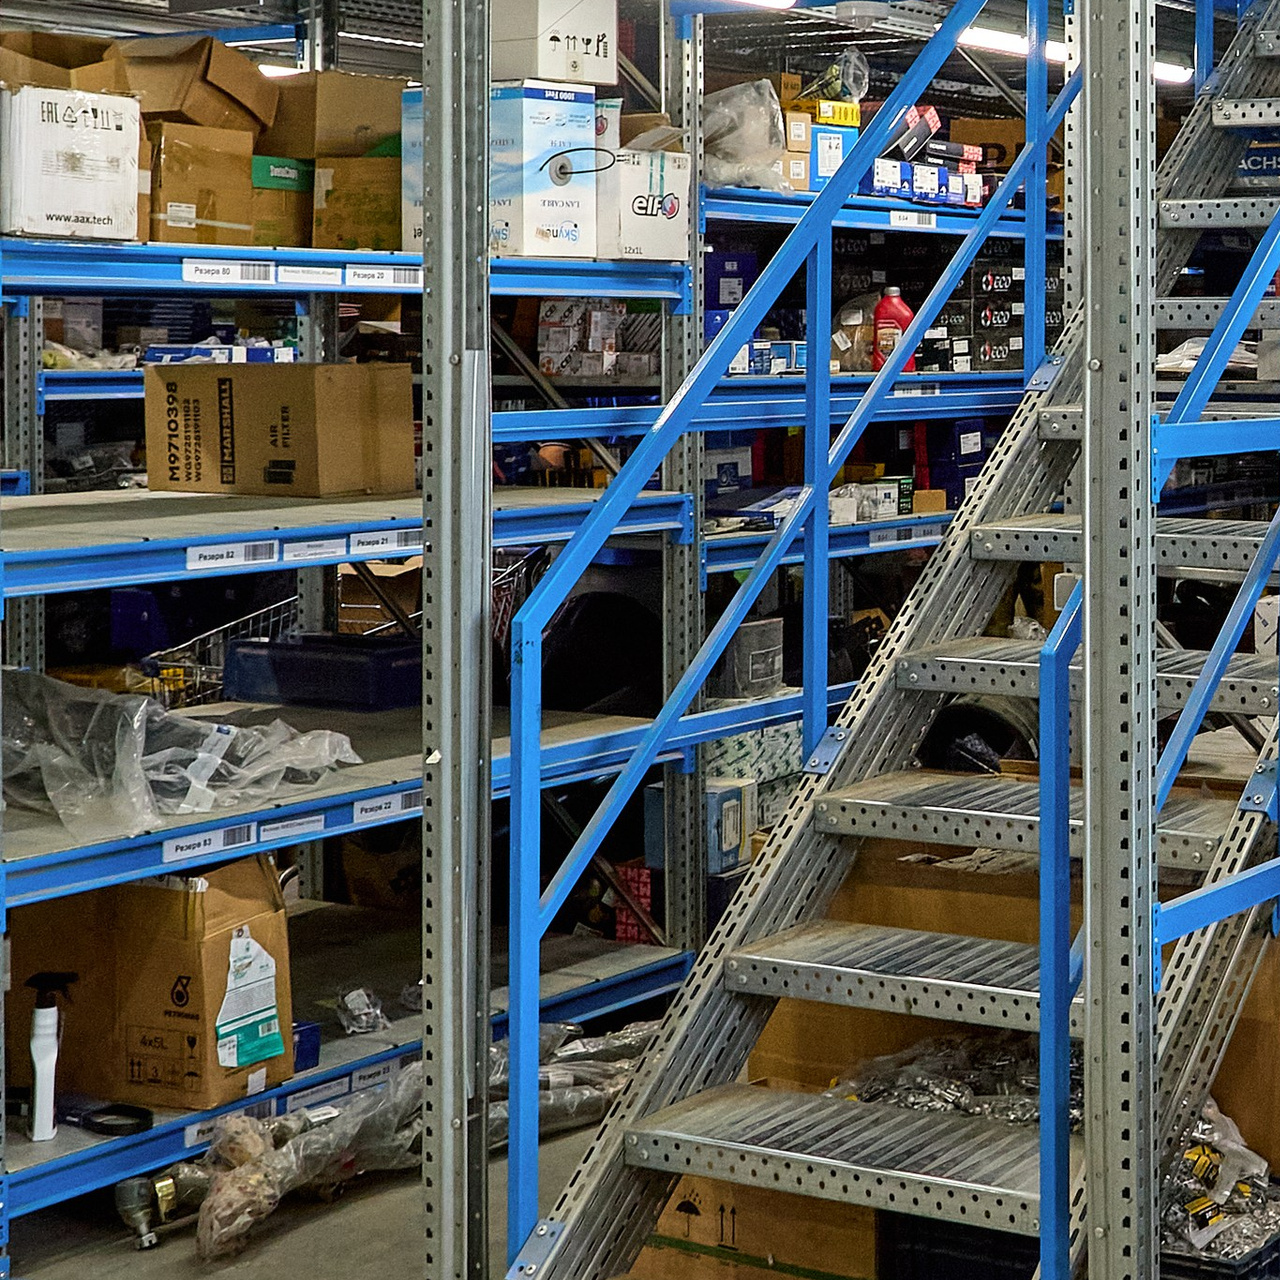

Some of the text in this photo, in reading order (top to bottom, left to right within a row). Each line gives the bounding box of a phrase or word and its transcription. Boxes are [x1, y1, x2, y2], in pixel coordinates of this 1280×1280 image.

[46, 211, 113, 227] www.aax.tech
[632, 195, 663, 217] elf
[167, 381, 180, 482] M9710398
[219, 380, 234, 461] MARSHALL
[269, 425, 279, 447] AIR
[281, 406, 290, 448] FILTER
